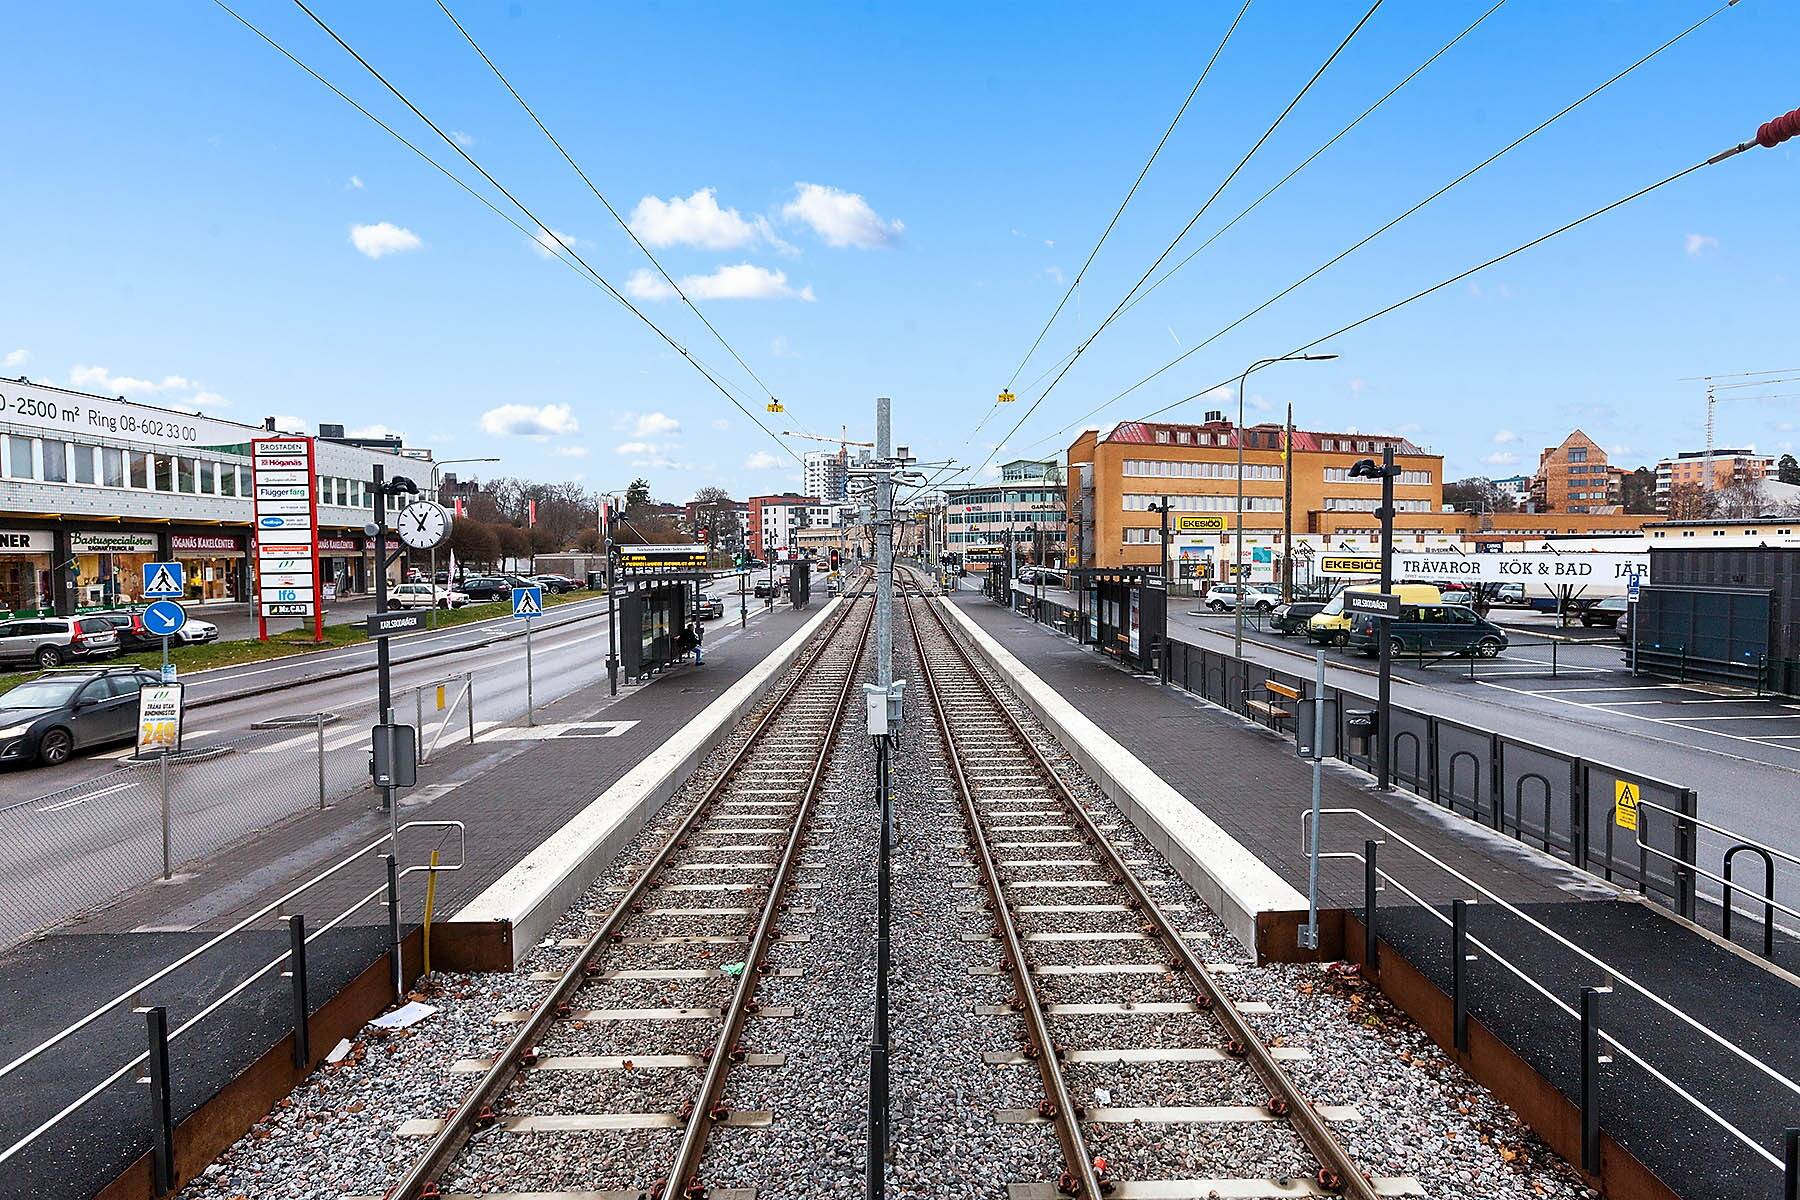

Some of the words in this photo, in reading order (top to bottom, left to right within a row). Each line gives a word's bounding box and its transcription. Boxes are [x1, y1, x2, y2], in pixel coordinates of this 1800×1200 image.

[88, 410, 117, 433] Ring
[120, 415, 164, 437] 08-602
[166, 424, 180, 439] 33
[182, 426, 197, 442] 00
[269, 459, 302, 467] Höganäs
[260, 488, 289, 497] Flügger
[71, 532, 153, 547] Bastuspecialisten
[1403, 558, 1481, 574] TRÄVAROR
[1499, 559, 1533, 575] KÖK
[1538, 562, 1549, 575] &
[1555, 563, 1592, 576] BAD
[1630, 575, 1638, 587] P
[278, 590, 296, 601] Ifö
